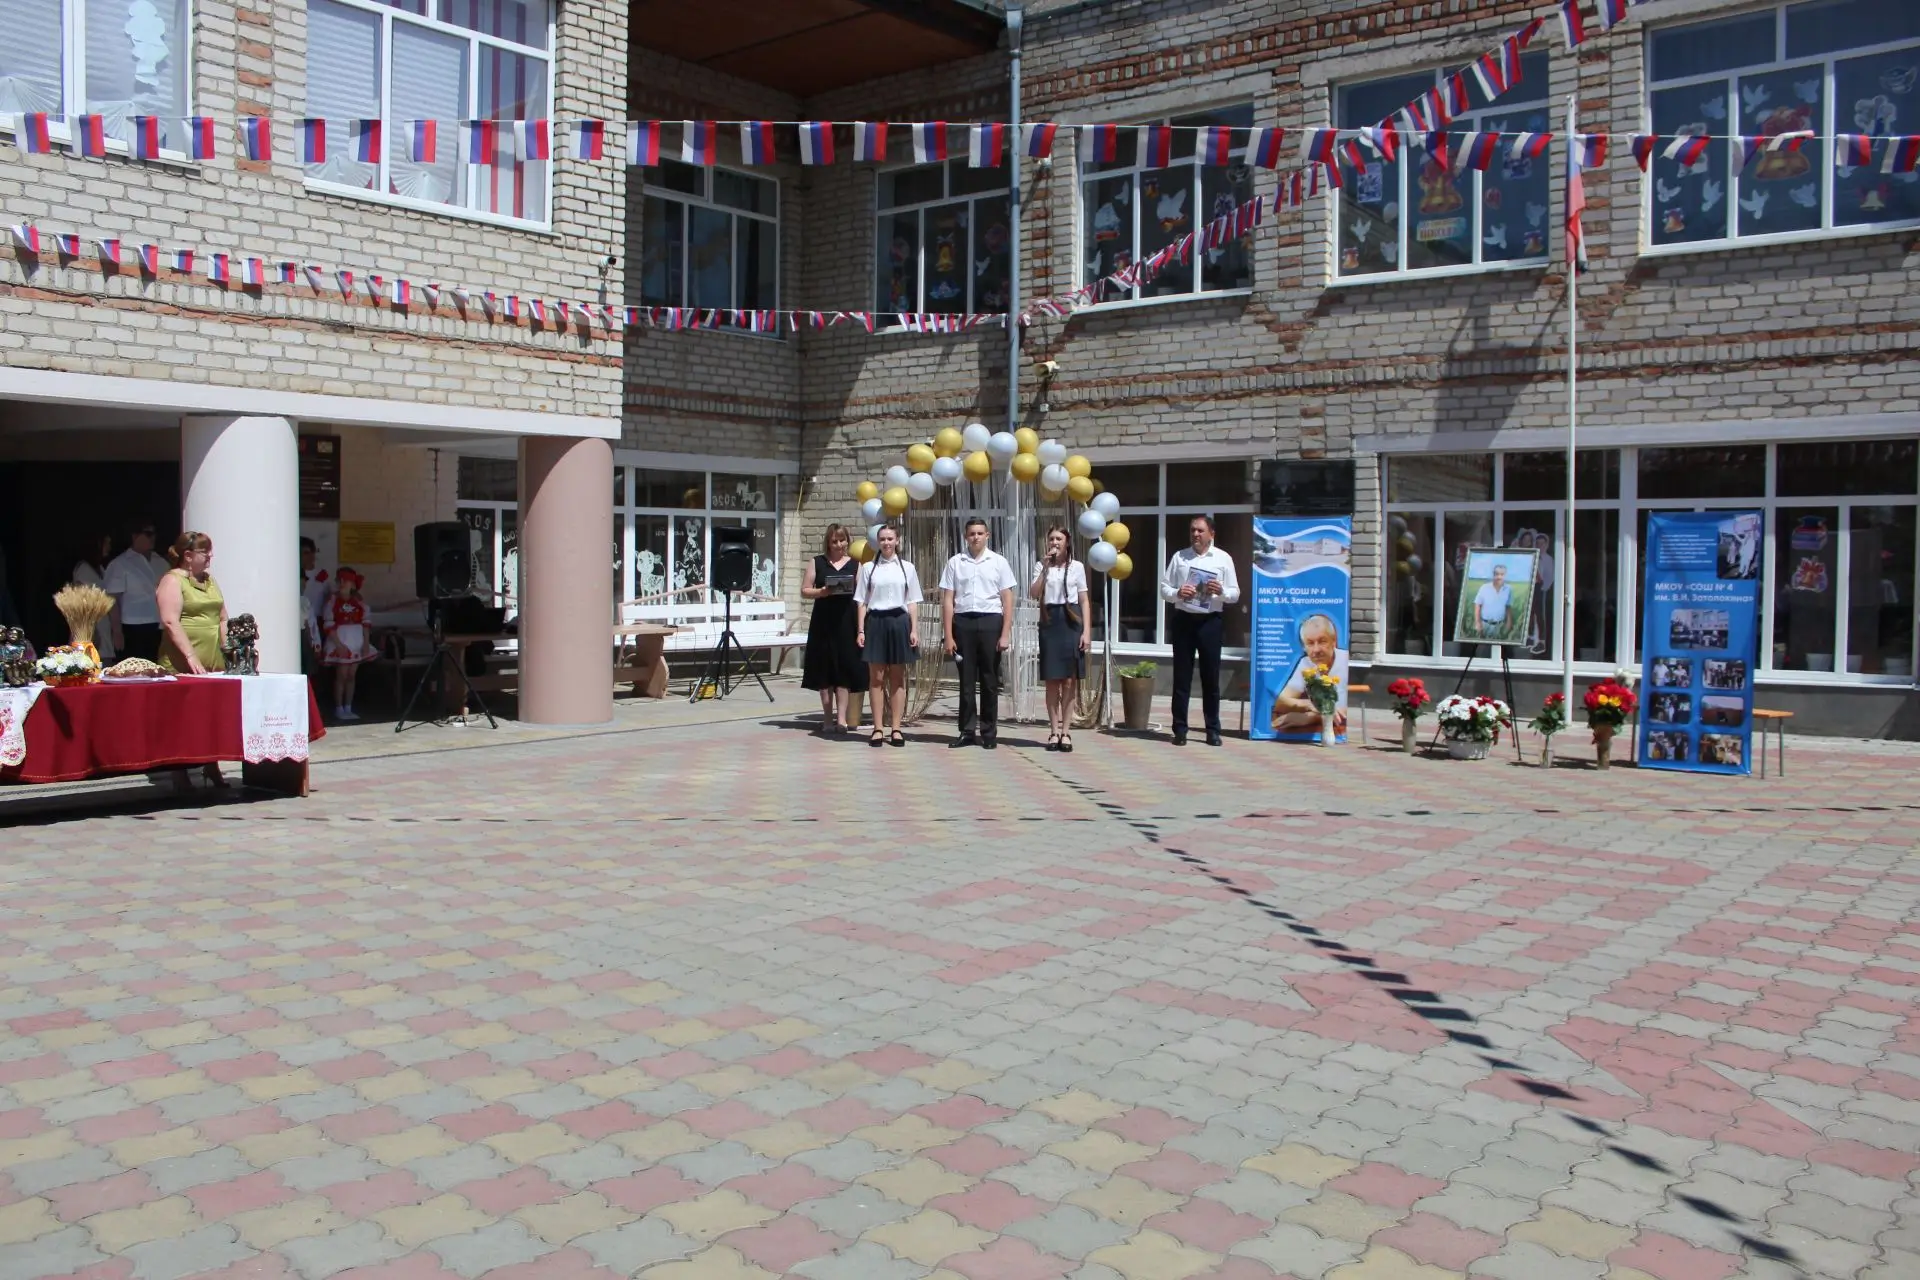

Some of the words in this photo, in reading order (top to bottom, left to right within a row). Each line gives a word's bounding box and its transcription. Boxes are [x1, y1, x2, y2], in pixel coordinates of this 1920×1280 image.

[1258, 587, 1283, 595] МКОУ
[1321, 587, 1326, 595] 4
[1655, 583, 1683, 591] МКОУ
[1727, 583, 1733, 591] 4
